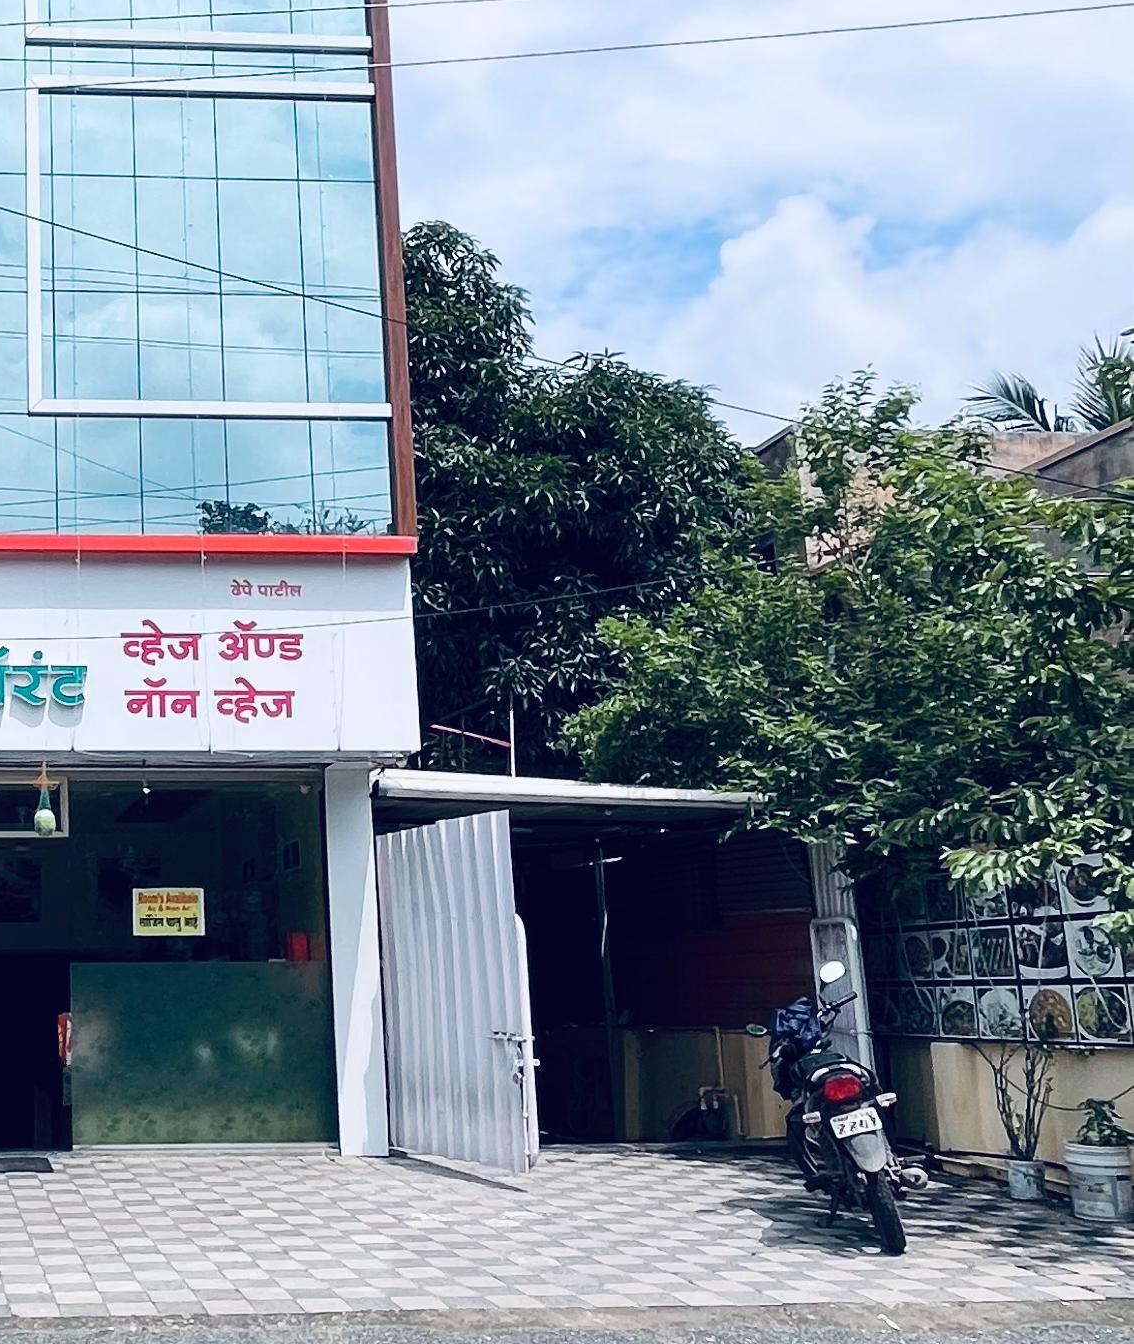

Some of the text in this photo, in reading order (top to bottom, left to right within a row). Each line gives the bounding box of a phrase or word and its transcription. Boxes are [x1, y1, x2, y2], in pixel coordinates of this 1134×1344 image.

[257, 579, 302, 597] पाटील
[120, 619, 202, 666] व्हेज
[124, 677, 295, 723] नॉन व्हेज
